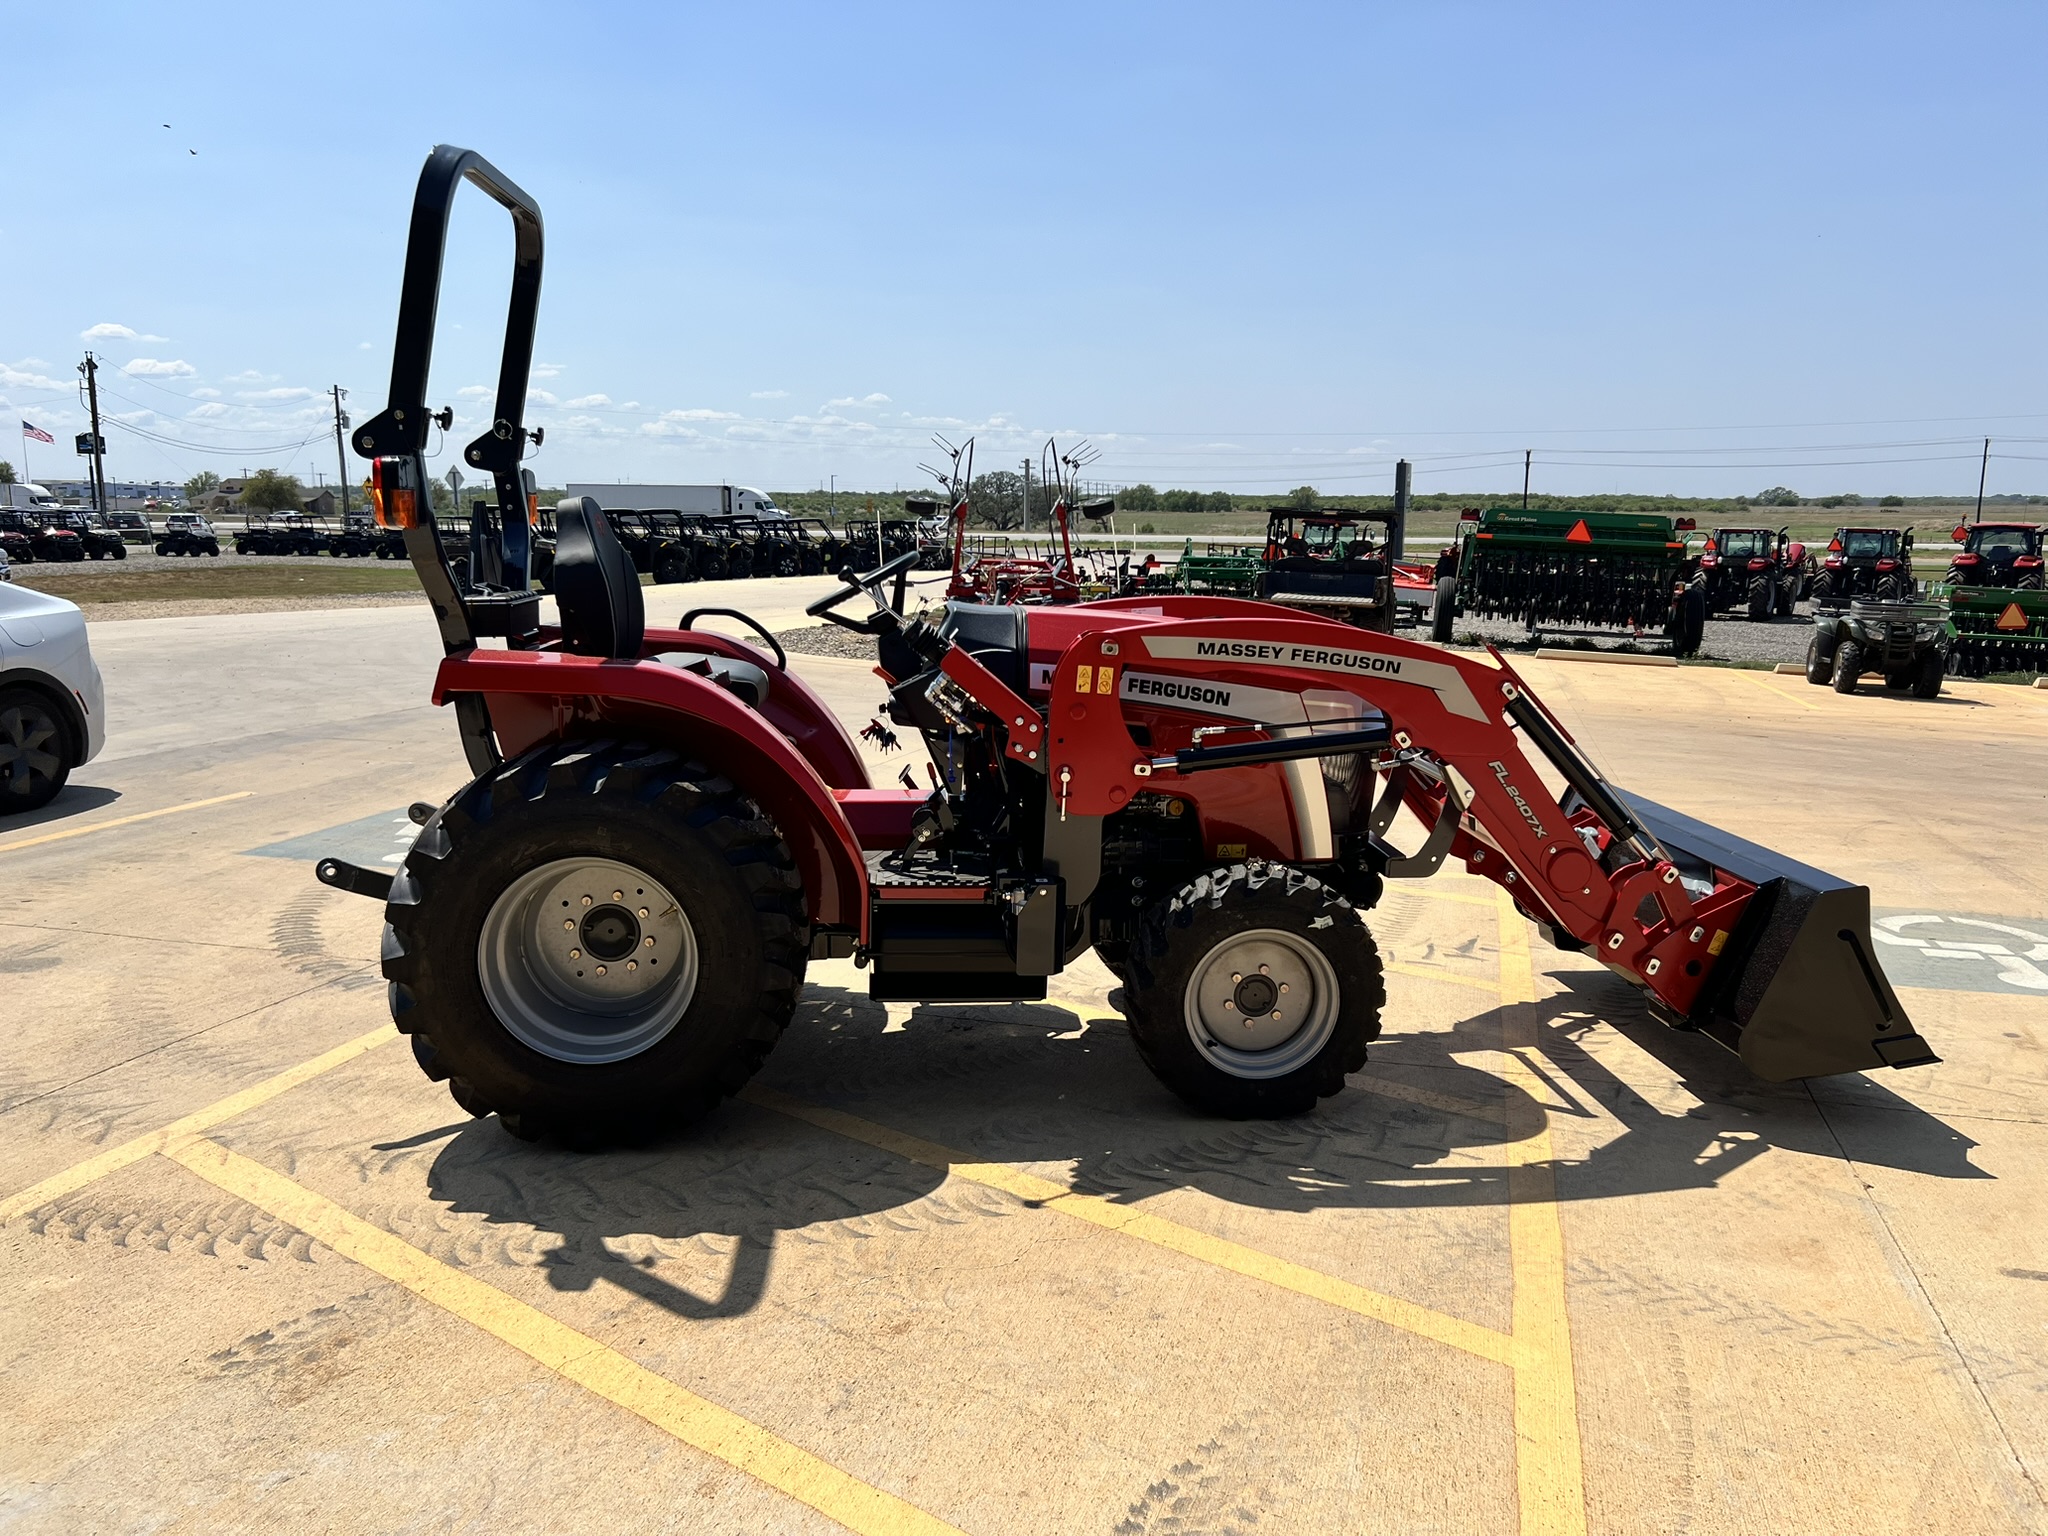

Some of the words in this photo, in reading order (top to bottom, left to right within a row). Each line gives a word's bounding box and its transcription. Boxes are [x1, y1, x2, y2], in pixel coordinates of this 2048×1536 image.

[1197, 642, 1284, 659] MASSEY
[1290, 648, 1401, 674] FERGUSON
[1127, 678, 1231, 707] FERGUSON
